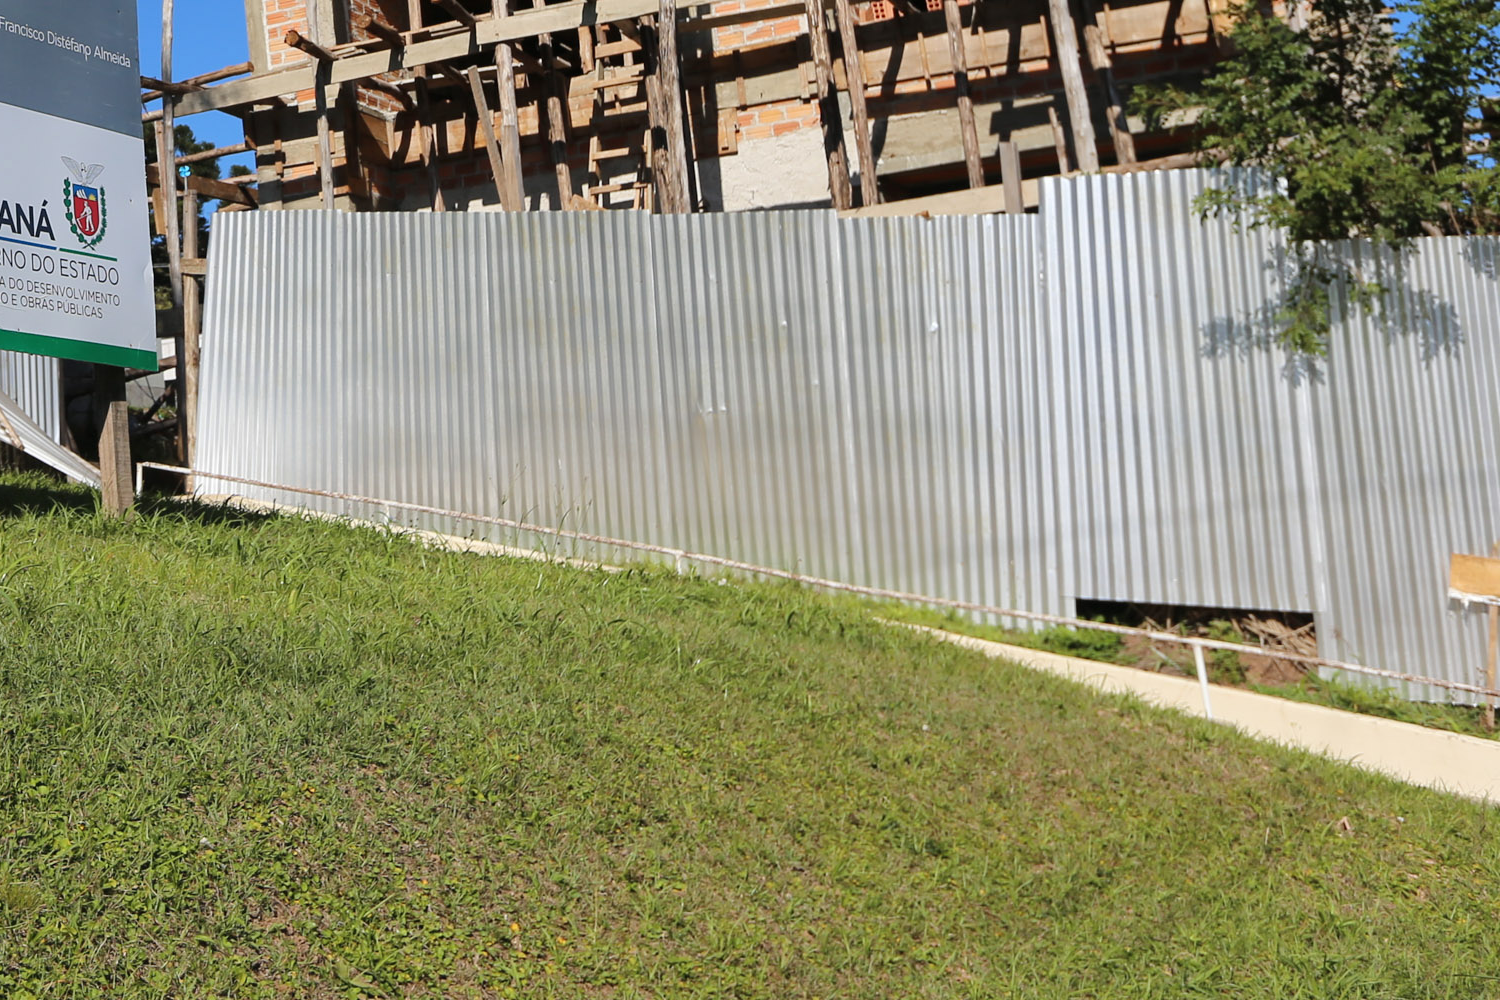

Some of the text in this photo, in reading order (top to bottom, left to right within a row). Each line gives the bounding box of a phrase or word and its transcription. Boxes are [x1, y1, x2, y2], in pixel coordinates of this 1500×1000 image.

[93, 45, 131, 68] Almeida
[31, 253, 55, 274] DO
[60, 259, 119, 286] ESTADO
[8, 277, 24, 291] DO
[27, 280, 121, 307] DESENVOLVIMENTO
[11, 294, 18, 306] E
[19, 294, 55, 312] OBRAS
[57, 297, 103, 319] PÚBLICAS
